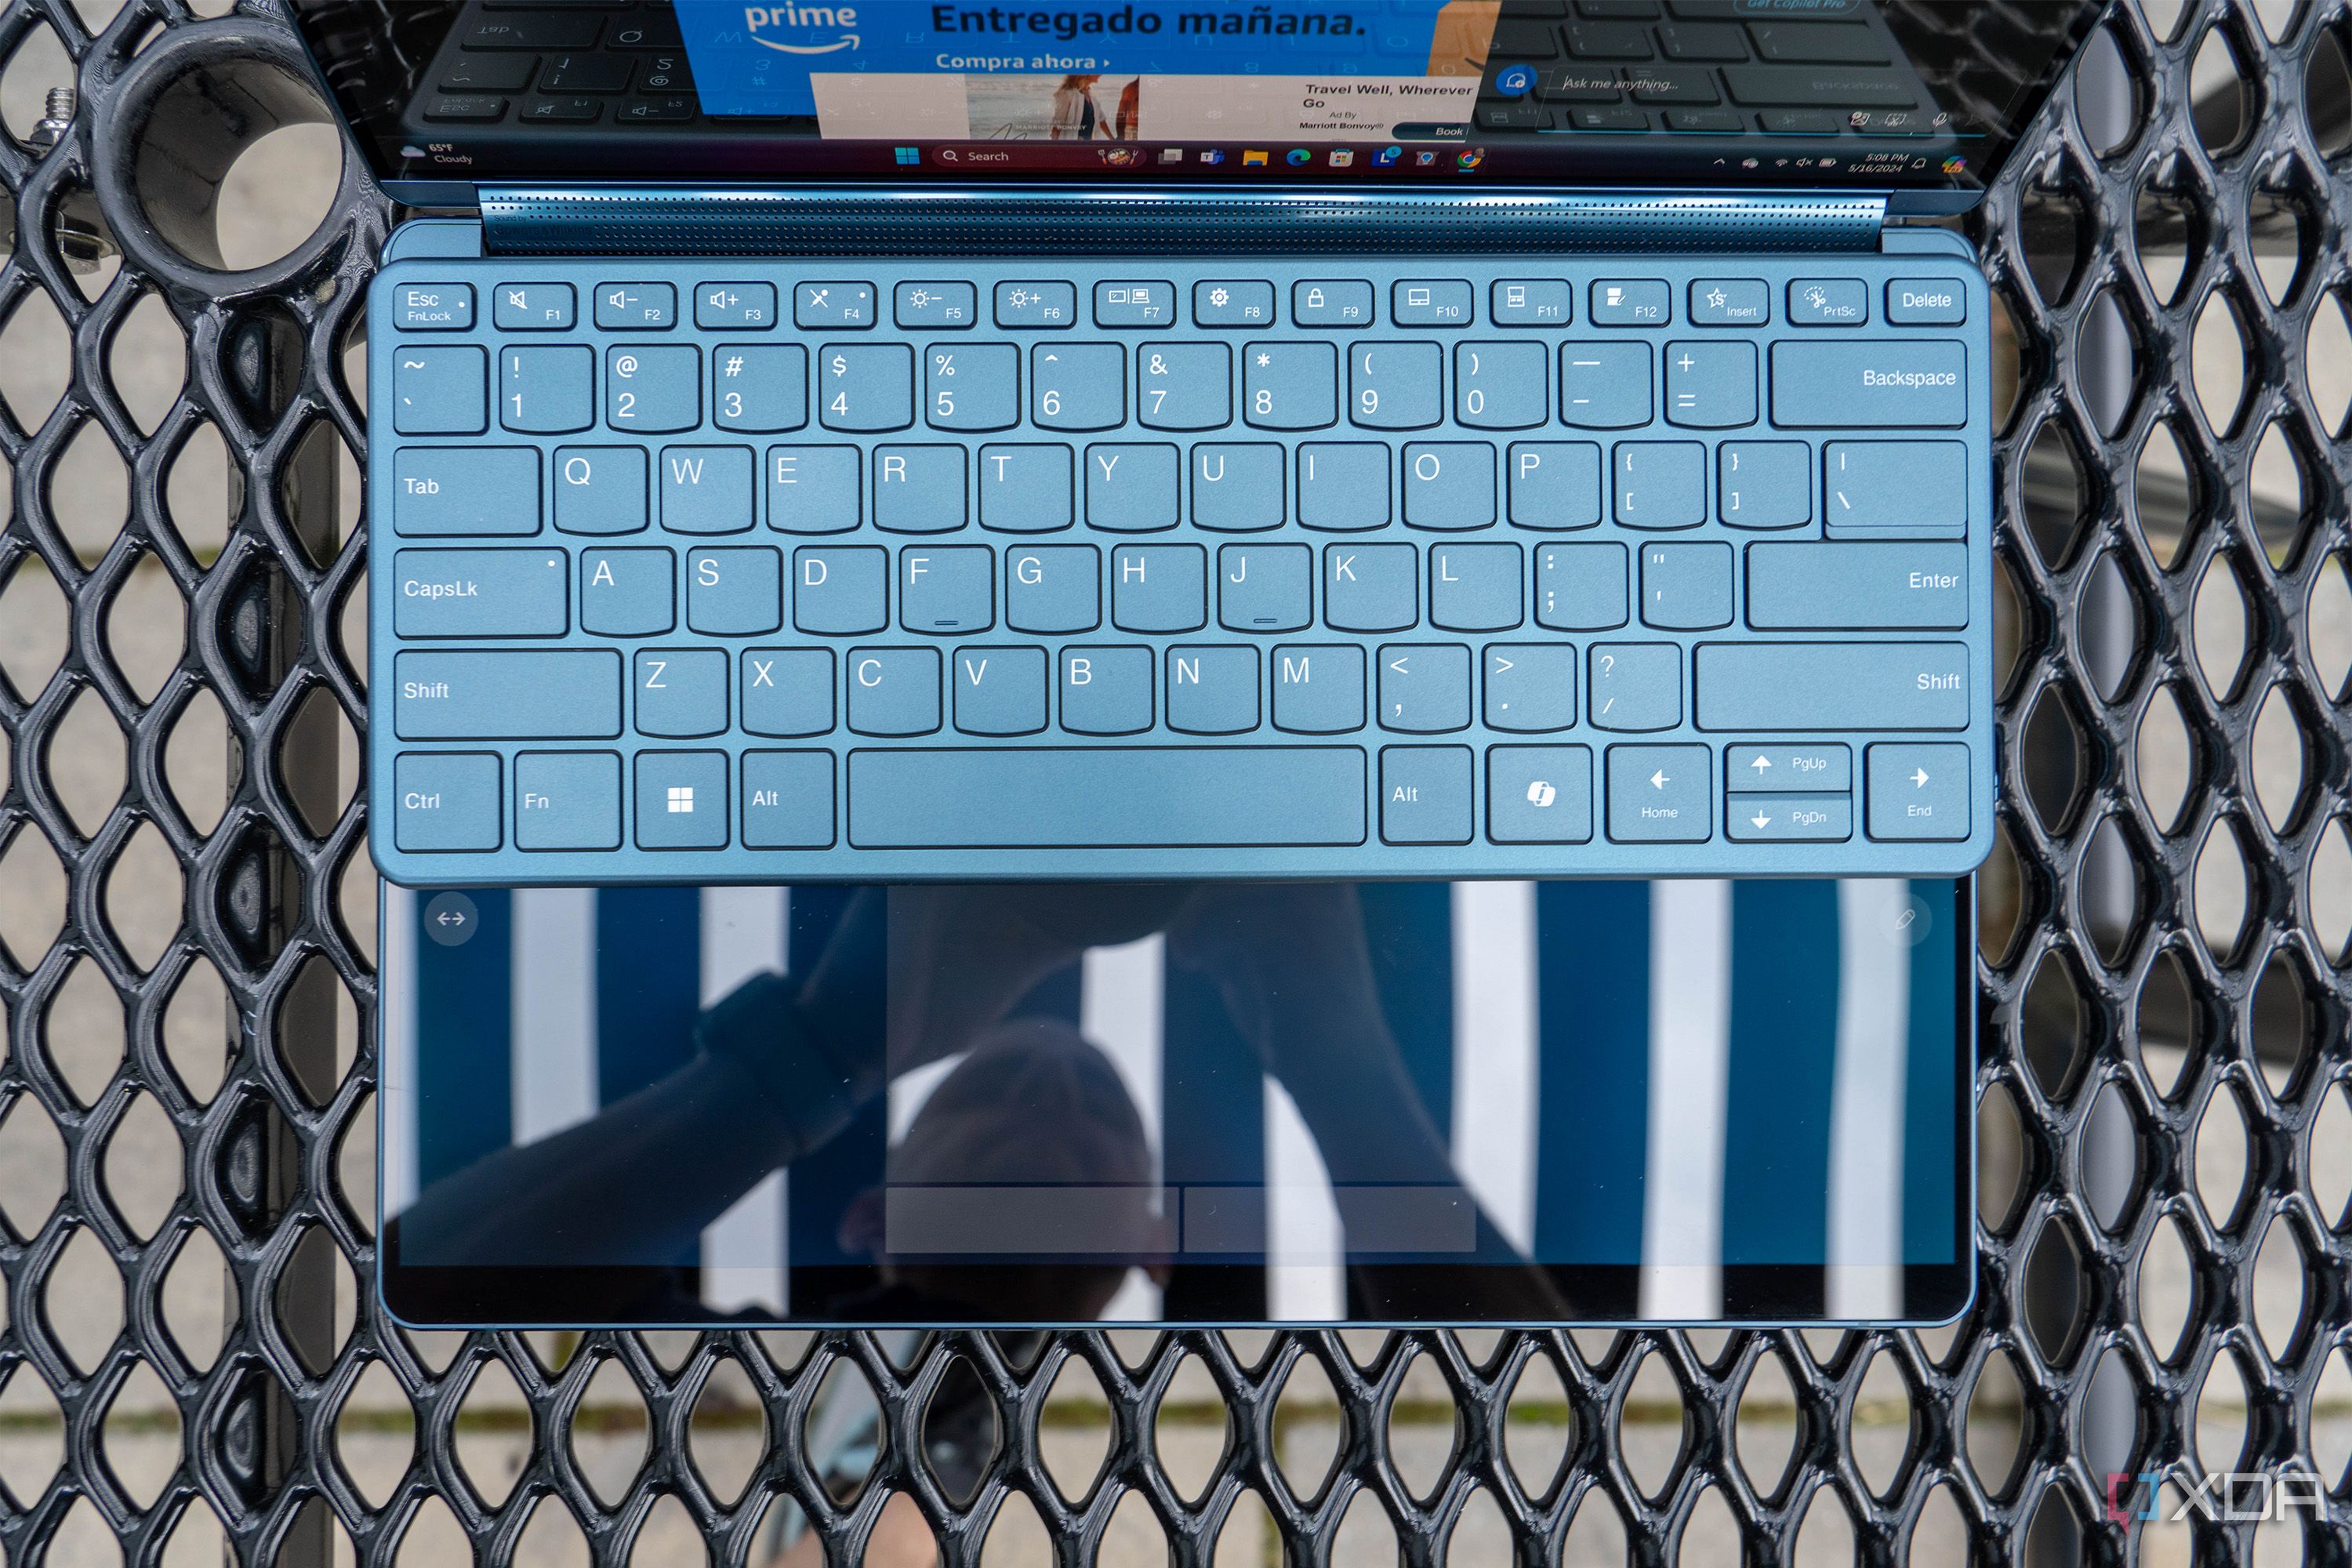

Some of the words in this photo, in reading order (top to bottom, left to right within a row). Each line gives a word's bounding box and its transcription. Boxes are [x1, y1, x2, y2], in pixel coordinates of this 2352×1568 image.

[745, 2, 857, 33] prime
[932, 5, 1162, 40] Entregado
[1178, 6, 1366, 36] mañana.
[936, 53, 1024, 72] Compra
[1031, 53, 1096, 69] ahora
[1305, 84, 1351, 95] Travel
[1356, 85, 1393, 97] Well,
[1398, 85, 1474, 96] Wherever
[1565, 78, 1587, 89] Ask
[1591, 80, 1611, 89] me
[1303, 98, 1325, 109] Go
[1345, 111, 1357, 120] By
[1436, 127, 1463, 136] Book
[429, 143, 453, 153] 65°F
[968, 151, 1009, 162] Search
[1890, 152, 1910, 163] PM
[434, 155, 473, 165] Cloudy
[1847, 164, 1904, 174] 5/16/2024
[408, 291, 439, 307] Esc
[1903, 292, 1951, 307] Delete
[408, 310, 452, 321] FnLock
[546, 309, 560, 321] F1
[644, 309, 661, 321] F2
[746, 309, 761, 321] F3
[844, 308, 860, 319] F4
[946, 307, 962, 319] F5
[1044, 307, 1060, 319] F6
[1144, 307, 1160, 318] F7
[1245, 307, 1261, 318] F8
[1343, 306, 1359, 318] F9
[1436, 306, 1459, 317] F10
[1537, 306, 1558, 317] F11
[1635, 306, 1657, 318] F12
[1727, 307, 1757, 317] Insert
[1824, 306, 1856, 317] PrtSc
[1864, 369, 1956, 390] Backspace
[511, 393, 521, 418] 1
[618, 392, 635, 417] 2
[724, 392, 742, 418] 3
[830, 391, 848, 416] 4
[937, 391, 954, 416] 5
[1043, 390, 1061, 416] 6
[1149, 390, 1167, 415] 7
[1255, 390, 1272, 415] 8
[1361, 389, 1378, 415] 9
[1467, 389, 1484, 415] 0
[564, 457, 591, 485] Q
[671, 458, 704, 485] W
[777, 457, 797, 484] E
[884, 456, 906, 482] R
[990, 456, 1012, 482] T
[1098, 455, 1120, 481] Y
[1203, 455, 1224, 481] U
[1415, 453, 1440, 481] O
[1521, 453, 1541, 480] P
[403, 477, 440, 495] Tab
[592, 560, 615, 586] A
[698, 558, 719, 586] S
[804, 559, 827, 586] D
[910, 557, 930, 585] F
[1017, 557, 1042, 584] G
[1123, 557, 1145, 583] H
[1230, 556, 1246, 583] J
[1336, 555, 1356, 582] K
[1442, 555, 1459, 582] L
[1909, 572, 1959, 589] Enter
[404, 580, 477, 601] CapsLk
[645, 661, 666, 688] Z
[753, 660, 774, 687] X
[858, 659, 882, 687] C
[965, 659, 988, 686] V
[1070, 658, 1092, 685] B
[1178, 658, 1200, 684] N
[1283, 657, 1309, 684] M
[404, 682, 449, 699] Shift
[1917, 673, 1960, 690] Shift
[1792, 757, 1827, 772] PgUp
[405, 793, 440, 809] Ctrl
[524, 793, 549, 809] Fn
[752, 790, 779, 806] Alt
[1392, 786, 1418, 802] Alt
[1642, 807, 1679, 818] Home
[1793, 811, 1827, 826] PgDn
[1907, 804, 1932, 817] End
